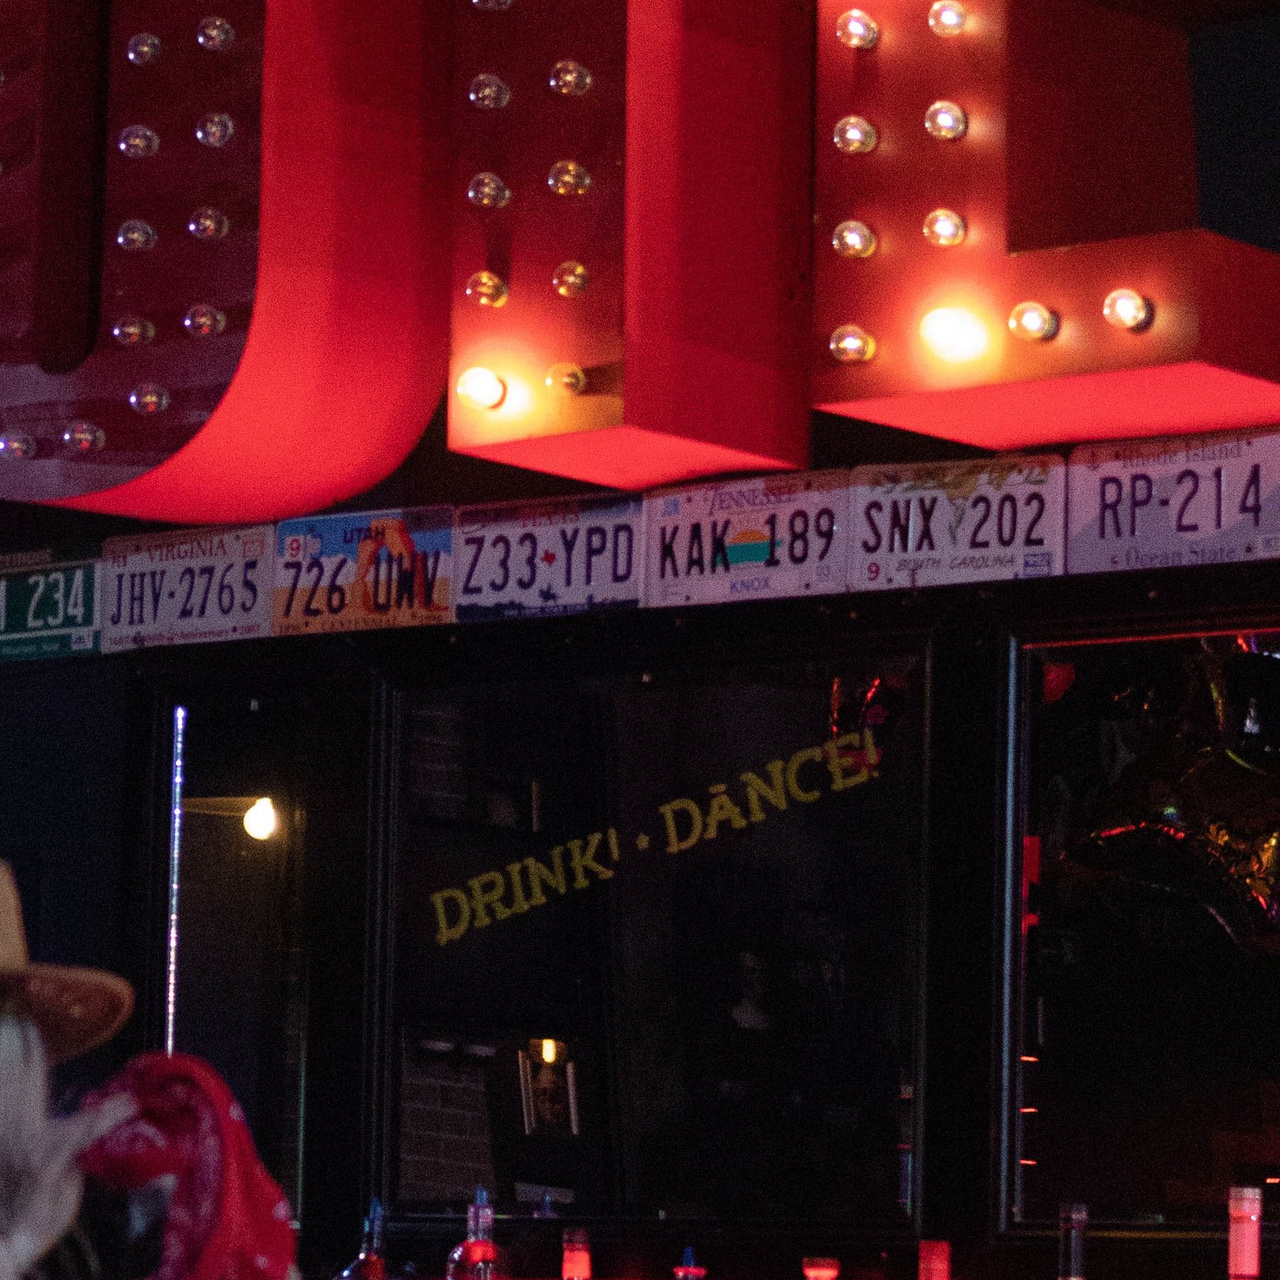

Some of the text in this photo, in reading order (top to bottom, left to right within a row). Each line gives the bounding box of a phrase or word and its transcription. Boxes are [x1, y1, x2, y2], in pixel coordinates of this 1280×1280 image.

[862, 493, 1045, 554] SNX 202
[1099, 464, 1261, 539] RP-214
[147, 538, 227, 563] VIRGINIA
[288, 537, 301, 558] 9
[342, 527, 385, 545] UTAH
[462, 524, 634, 594] Z33 YPD
[660, 508, 835, 579] KAK 189
[27, 568, 85, 628] 234
[283, 558, 347, 617] 726
[730, 576, 772, 594] KNOX
[867, 562, 880, 581] 9
